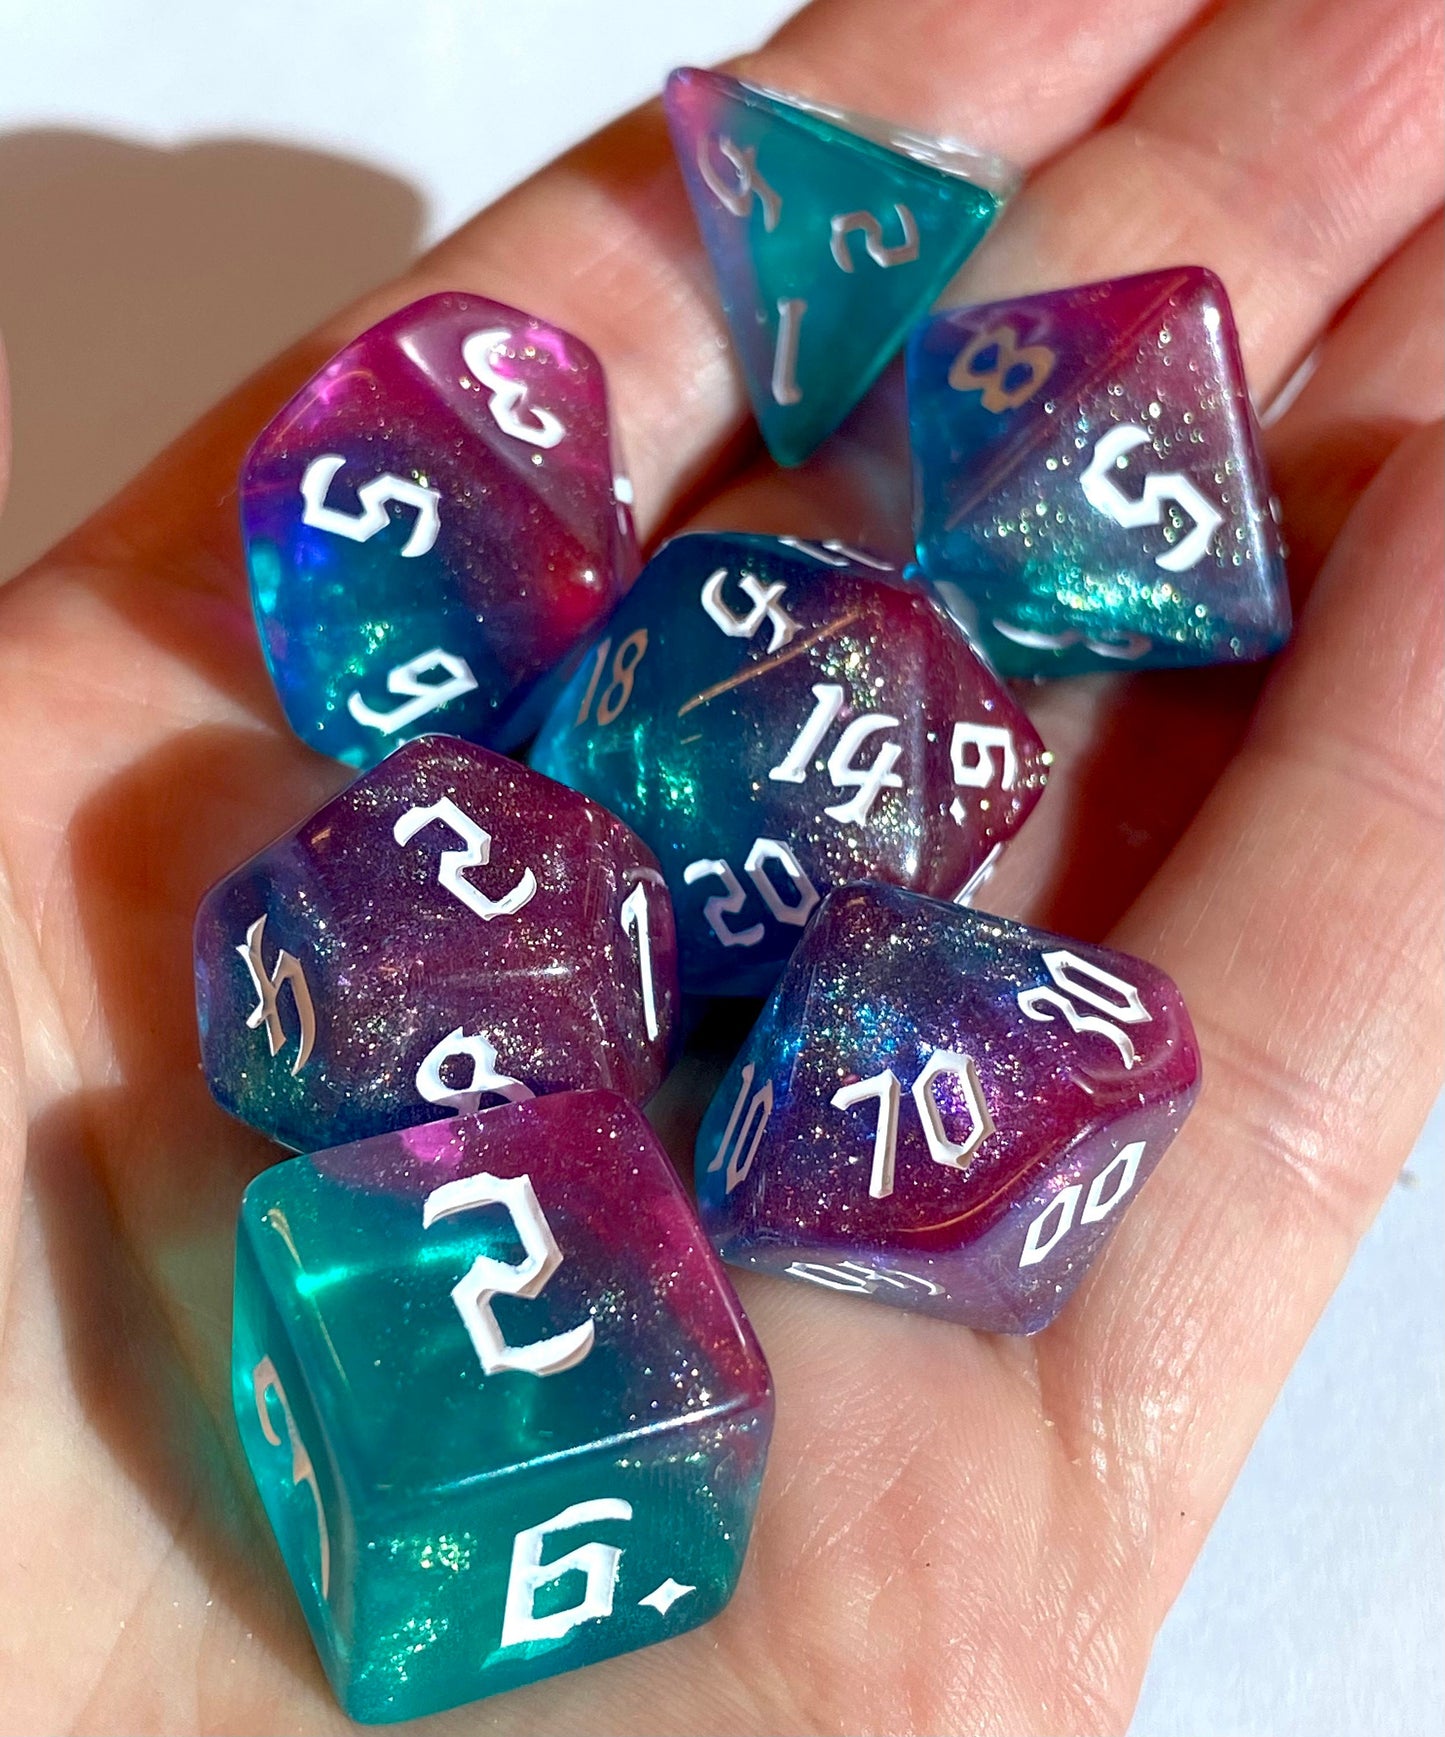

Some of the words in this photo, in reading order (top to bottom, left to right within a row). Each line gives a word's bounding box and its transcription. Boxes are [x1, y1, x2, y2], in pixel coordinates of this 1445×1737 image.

[830, 204, 919, 272] 2
[462, 329, 566, 449] 3
[772, 299, 806, 405] 1
[948, 325, 1056, 414] 8
[302, 454, 442, 557] 5
[1080, 424, 1222, 572] 5
[701, 567, 803, 654] 4
[576, 628, 648, 727] 18
[768, 684, 902, 827] 14
[393, 796, 538, 921] 2
[684, 838, 821, 948] 20
[235, 913, 317, 1077] 4
[621, 882, 659, 1042] 1
[1017, 950, 1153, 1070] 30
[707, 1063, 773, 1194] 10
[831, 1050, 995, 1199] 70
[1019, 1141, 1146, 1267] 00
[423, 1172, 595, 1376] 2
